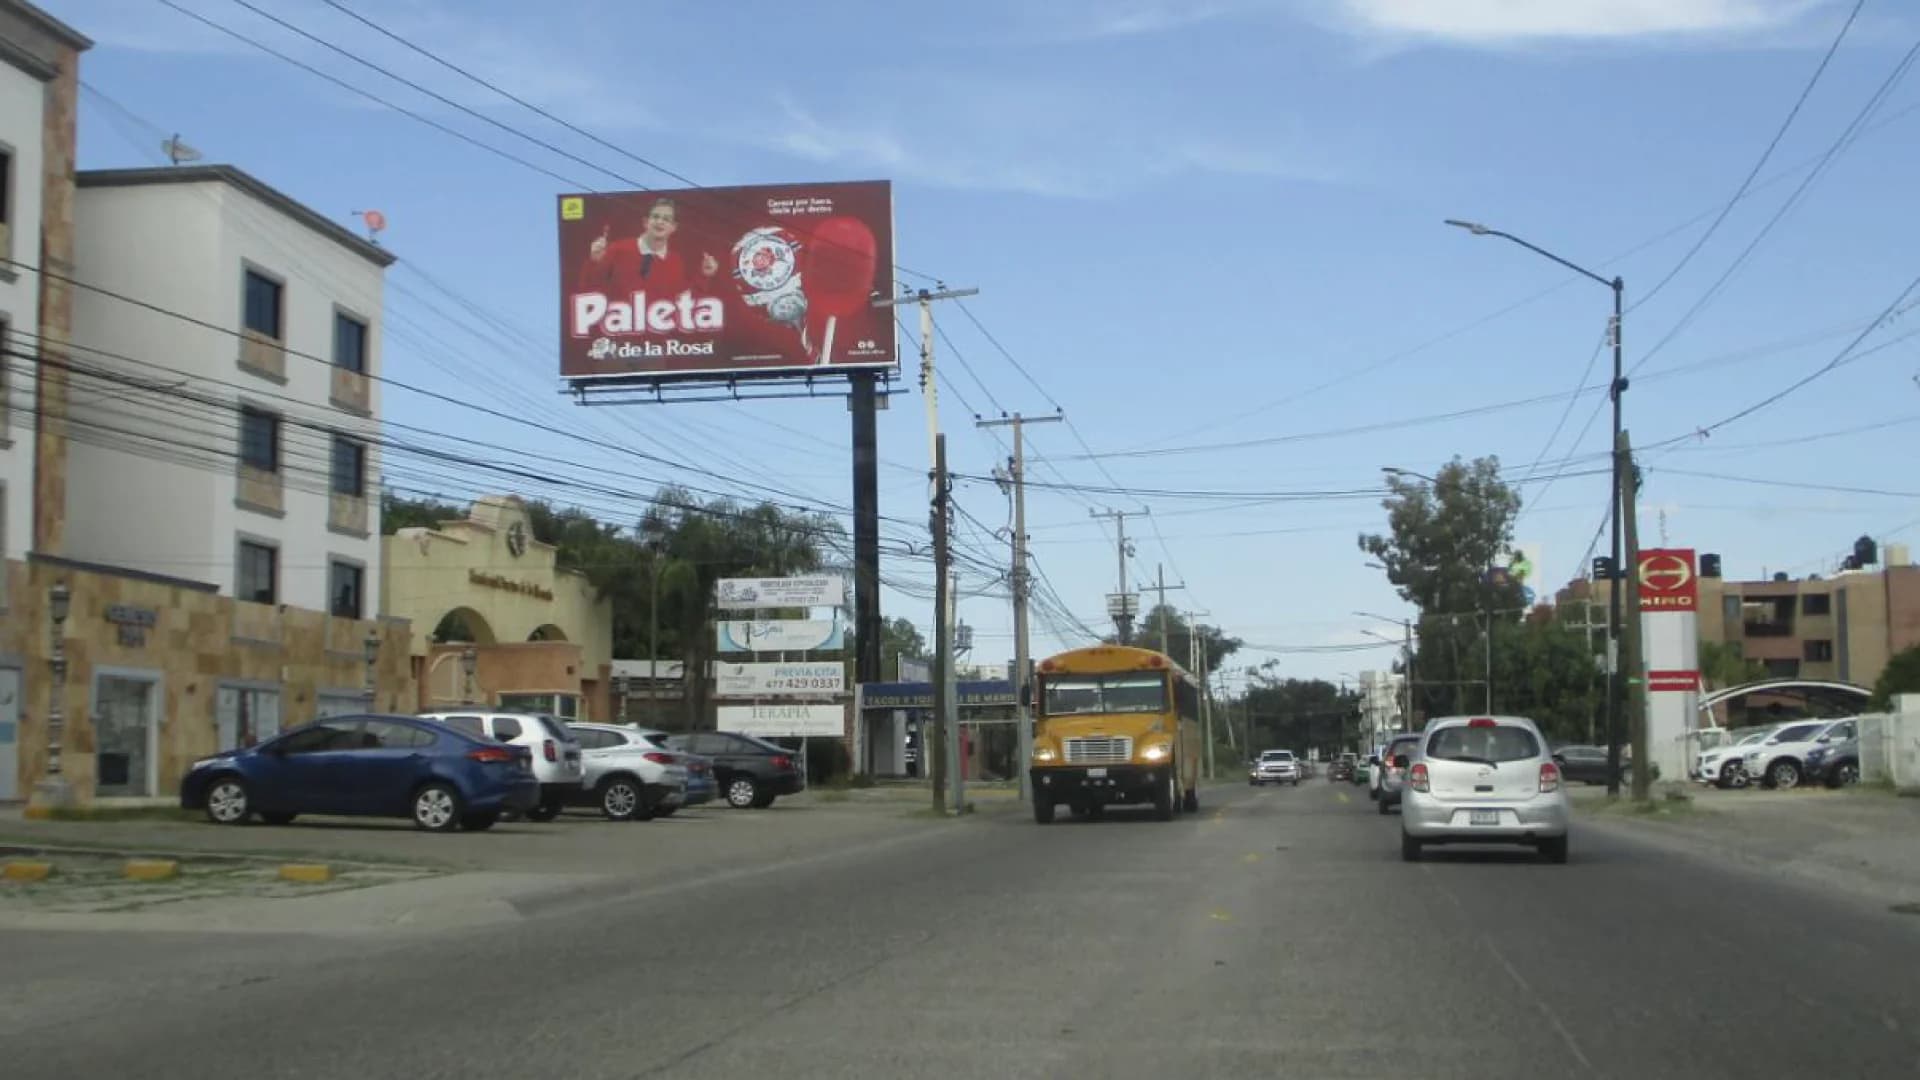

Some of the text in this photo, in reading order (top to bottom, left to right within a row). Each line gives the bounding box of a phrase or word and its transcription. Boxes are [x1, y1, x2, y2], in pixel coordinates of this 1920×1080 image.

[572, 291, 724, 336] Paleta
[618, 339, 714, 358] de la Rosa
[1640, 596, 1692, 606] HINO
[774, 665, 838, 677] PREVIA CITA
[766, 679, 784, 689] 477
[786, 678, 808, 689] 429
[810, 678, 840, 689] 0337
[751, 705, 811, 720] TERAPIA
